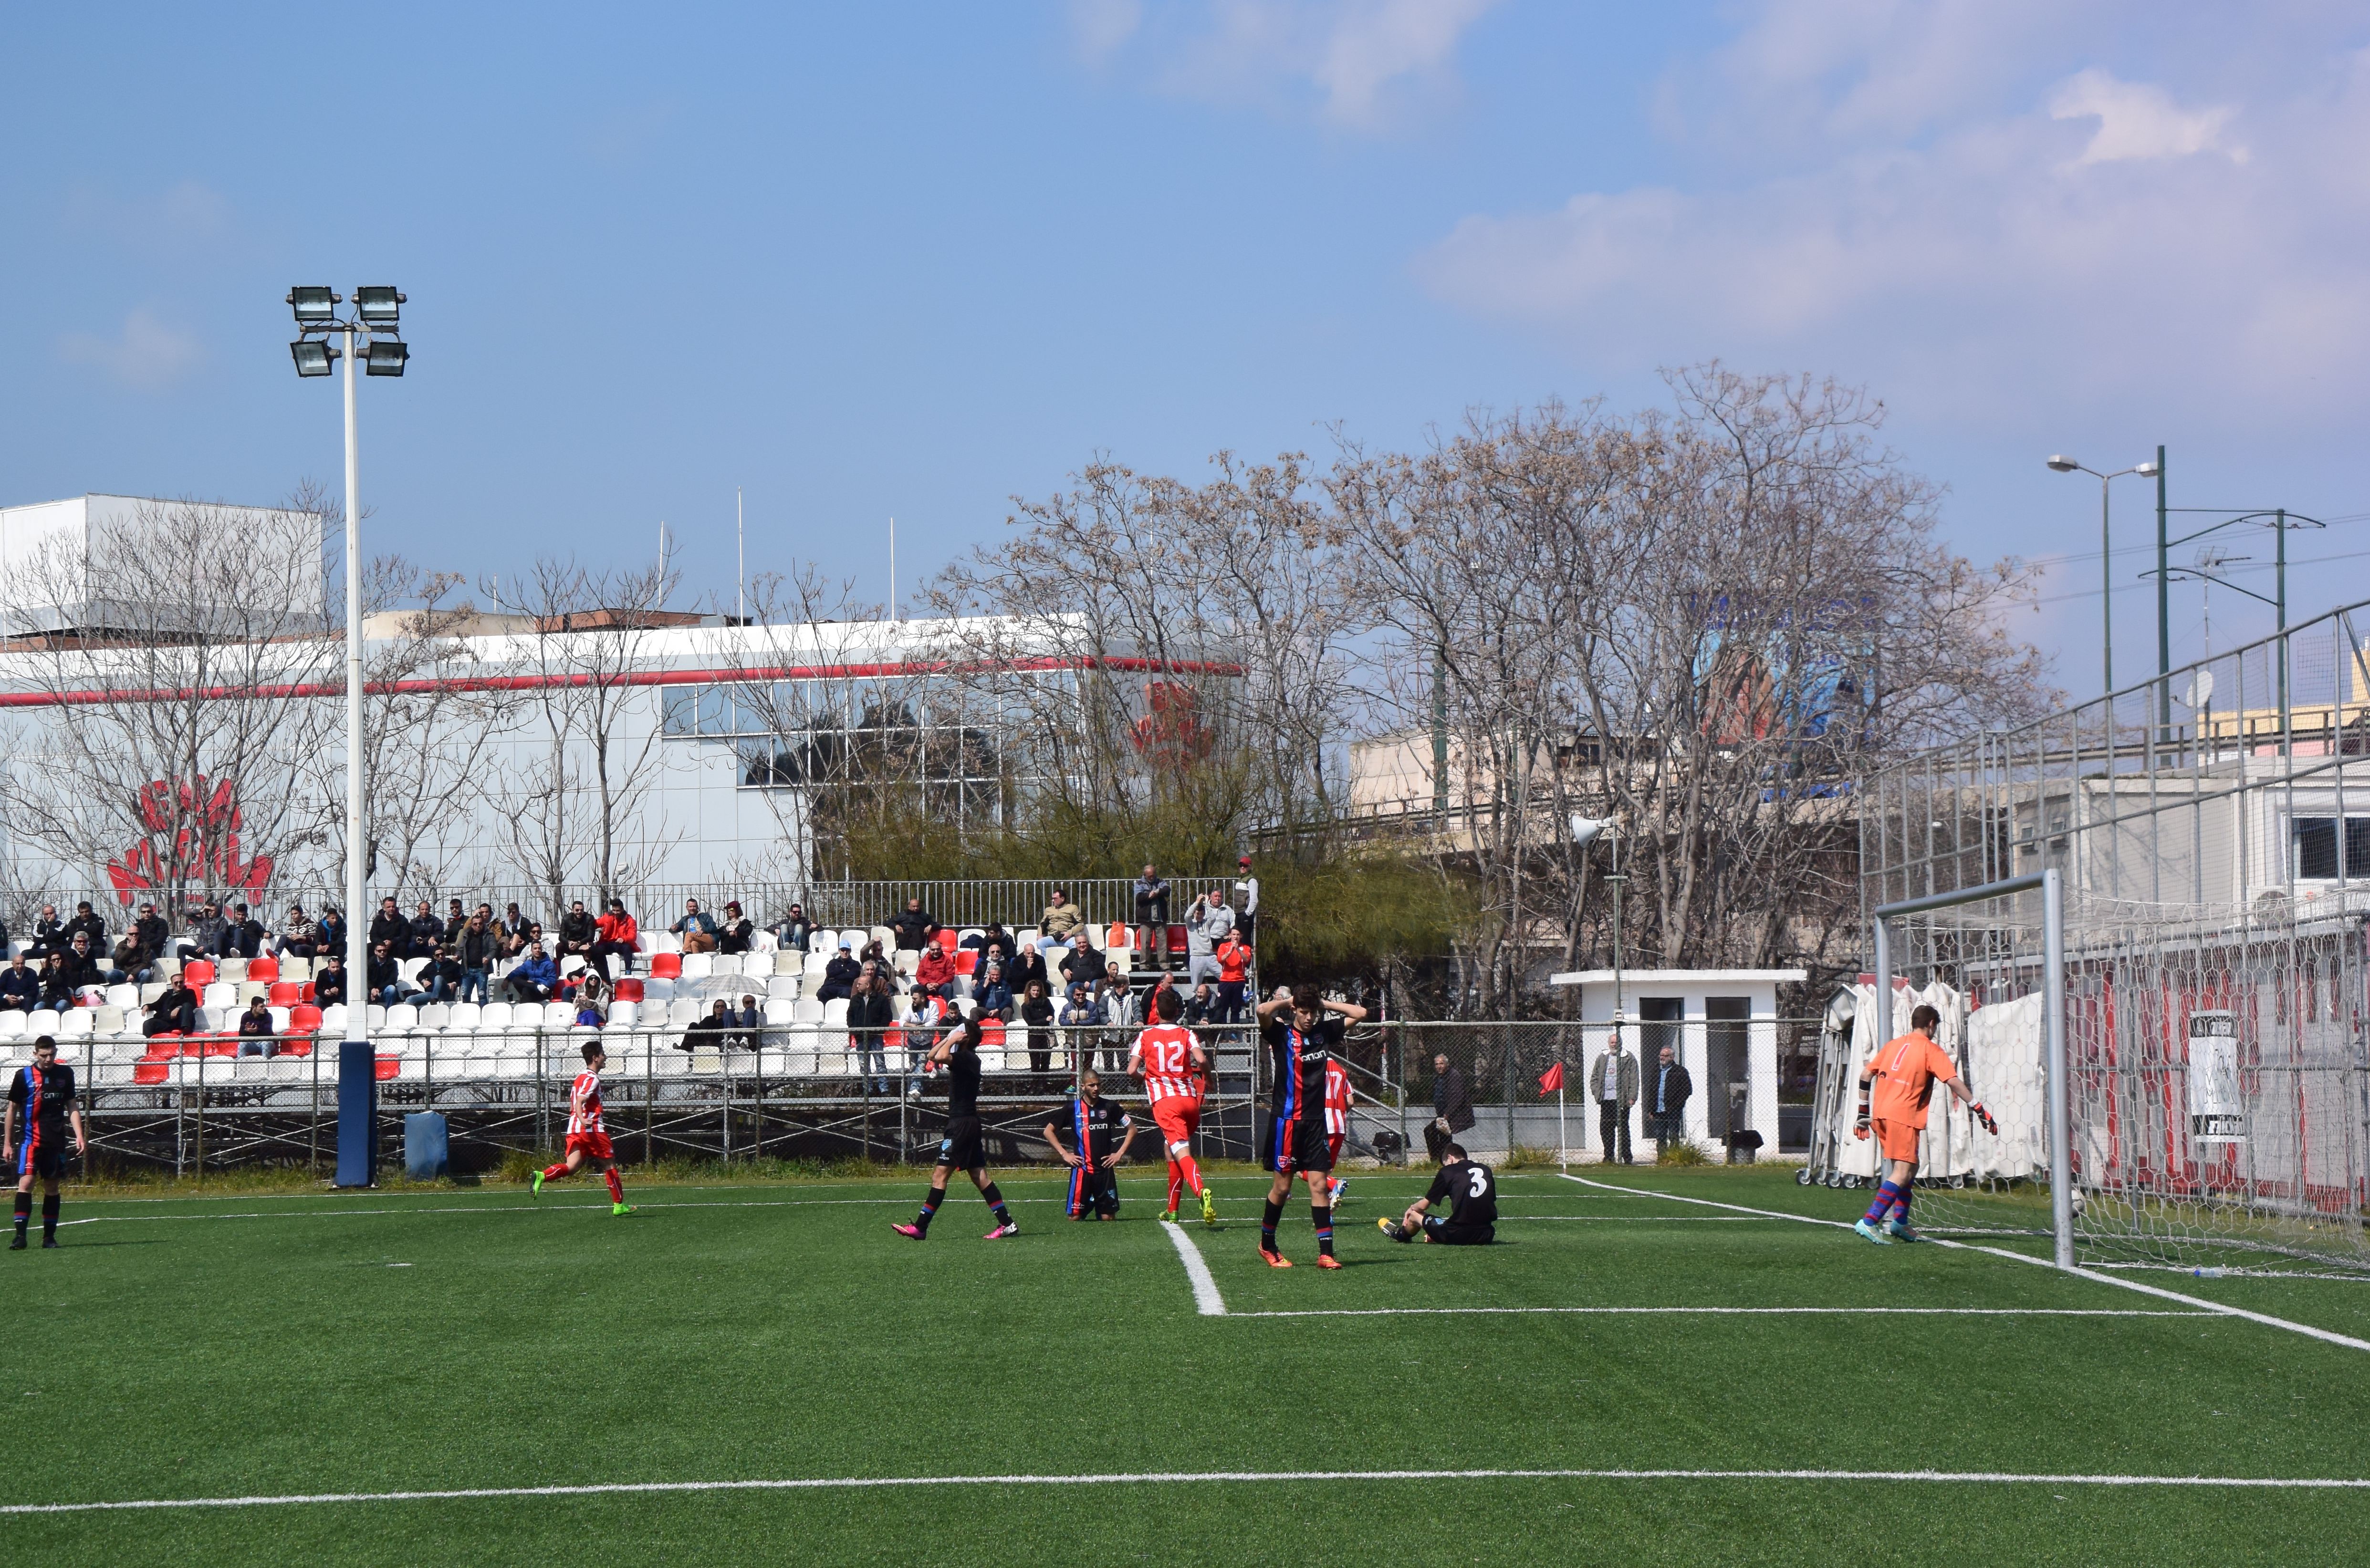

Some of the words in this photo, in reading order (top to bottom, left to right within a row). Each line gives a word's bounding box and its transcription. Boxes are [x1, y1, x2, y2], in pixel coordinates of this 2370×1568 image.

[1153, 1041, 1184, 1072] 12
[1891, 1043, 1911, 1071] 1
[1467, 1167, 1487, 1198] 3
